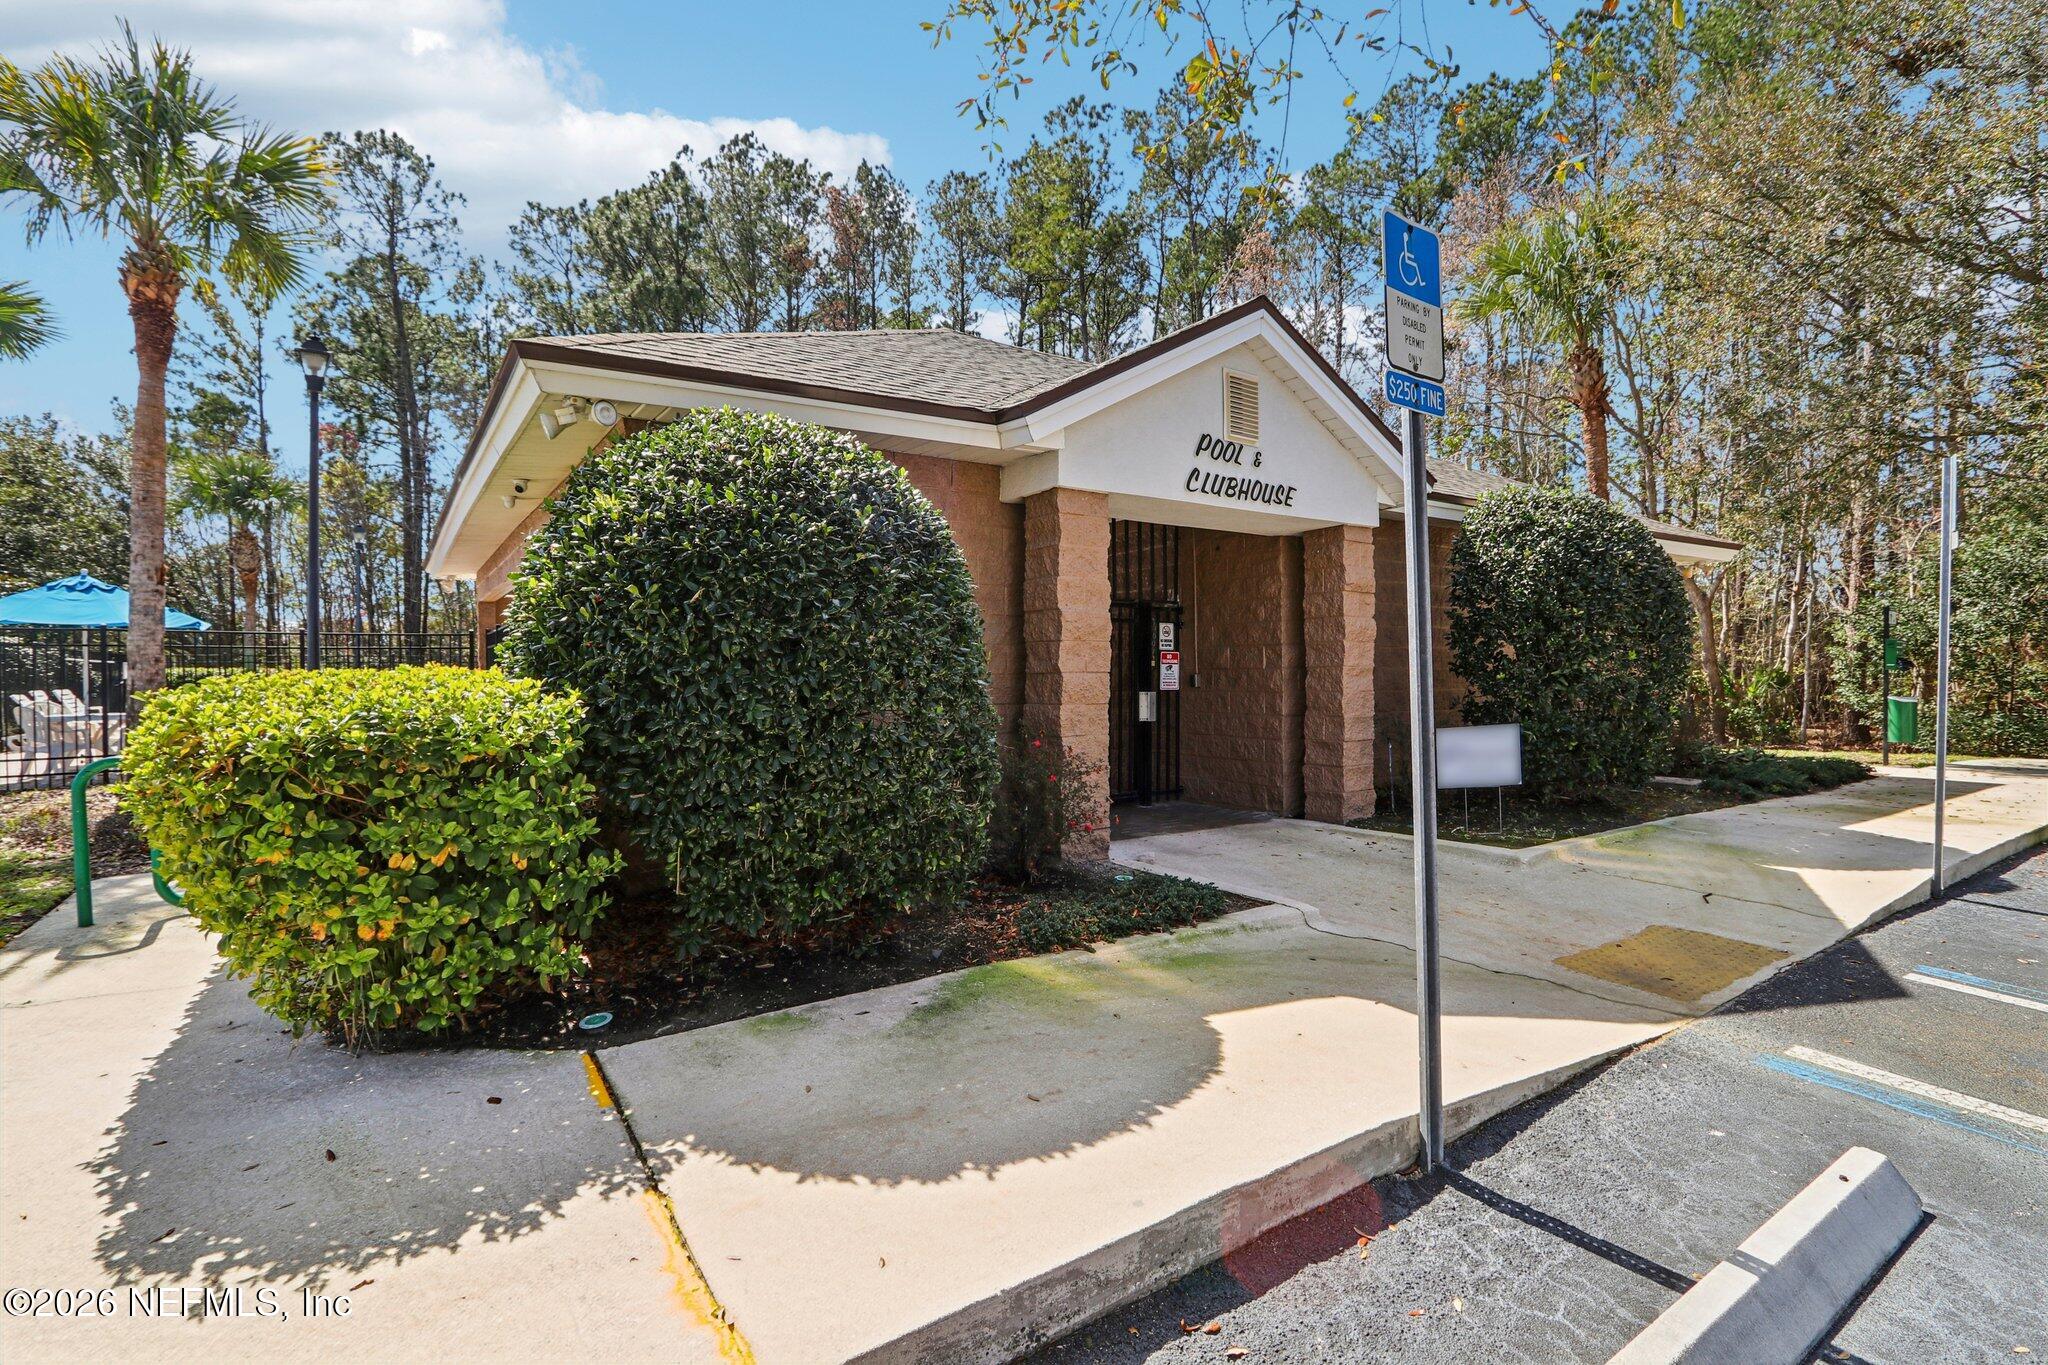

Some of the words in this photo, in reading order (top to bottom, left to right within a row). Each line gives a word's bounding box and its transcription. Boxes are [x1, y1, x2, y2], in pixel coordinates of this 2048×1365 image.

[1396, 296, 1420, 314] PARKING
[1423, 307, 1431, 318] BY
[1402, 315, 1426, 334] DISABLED
[1404, 334, 1425, 351] PERMIT
[1408, 352, 1423, 367] ONLY
[1389, 374, 1417, 403] $250
[1421, 386, 1443, 411] FINE
[1195, 433, 1244, 466] POOL
[1253, 451, 1262, 468] &
[1186, 467, 1297, 507] CLUBHOUSE
